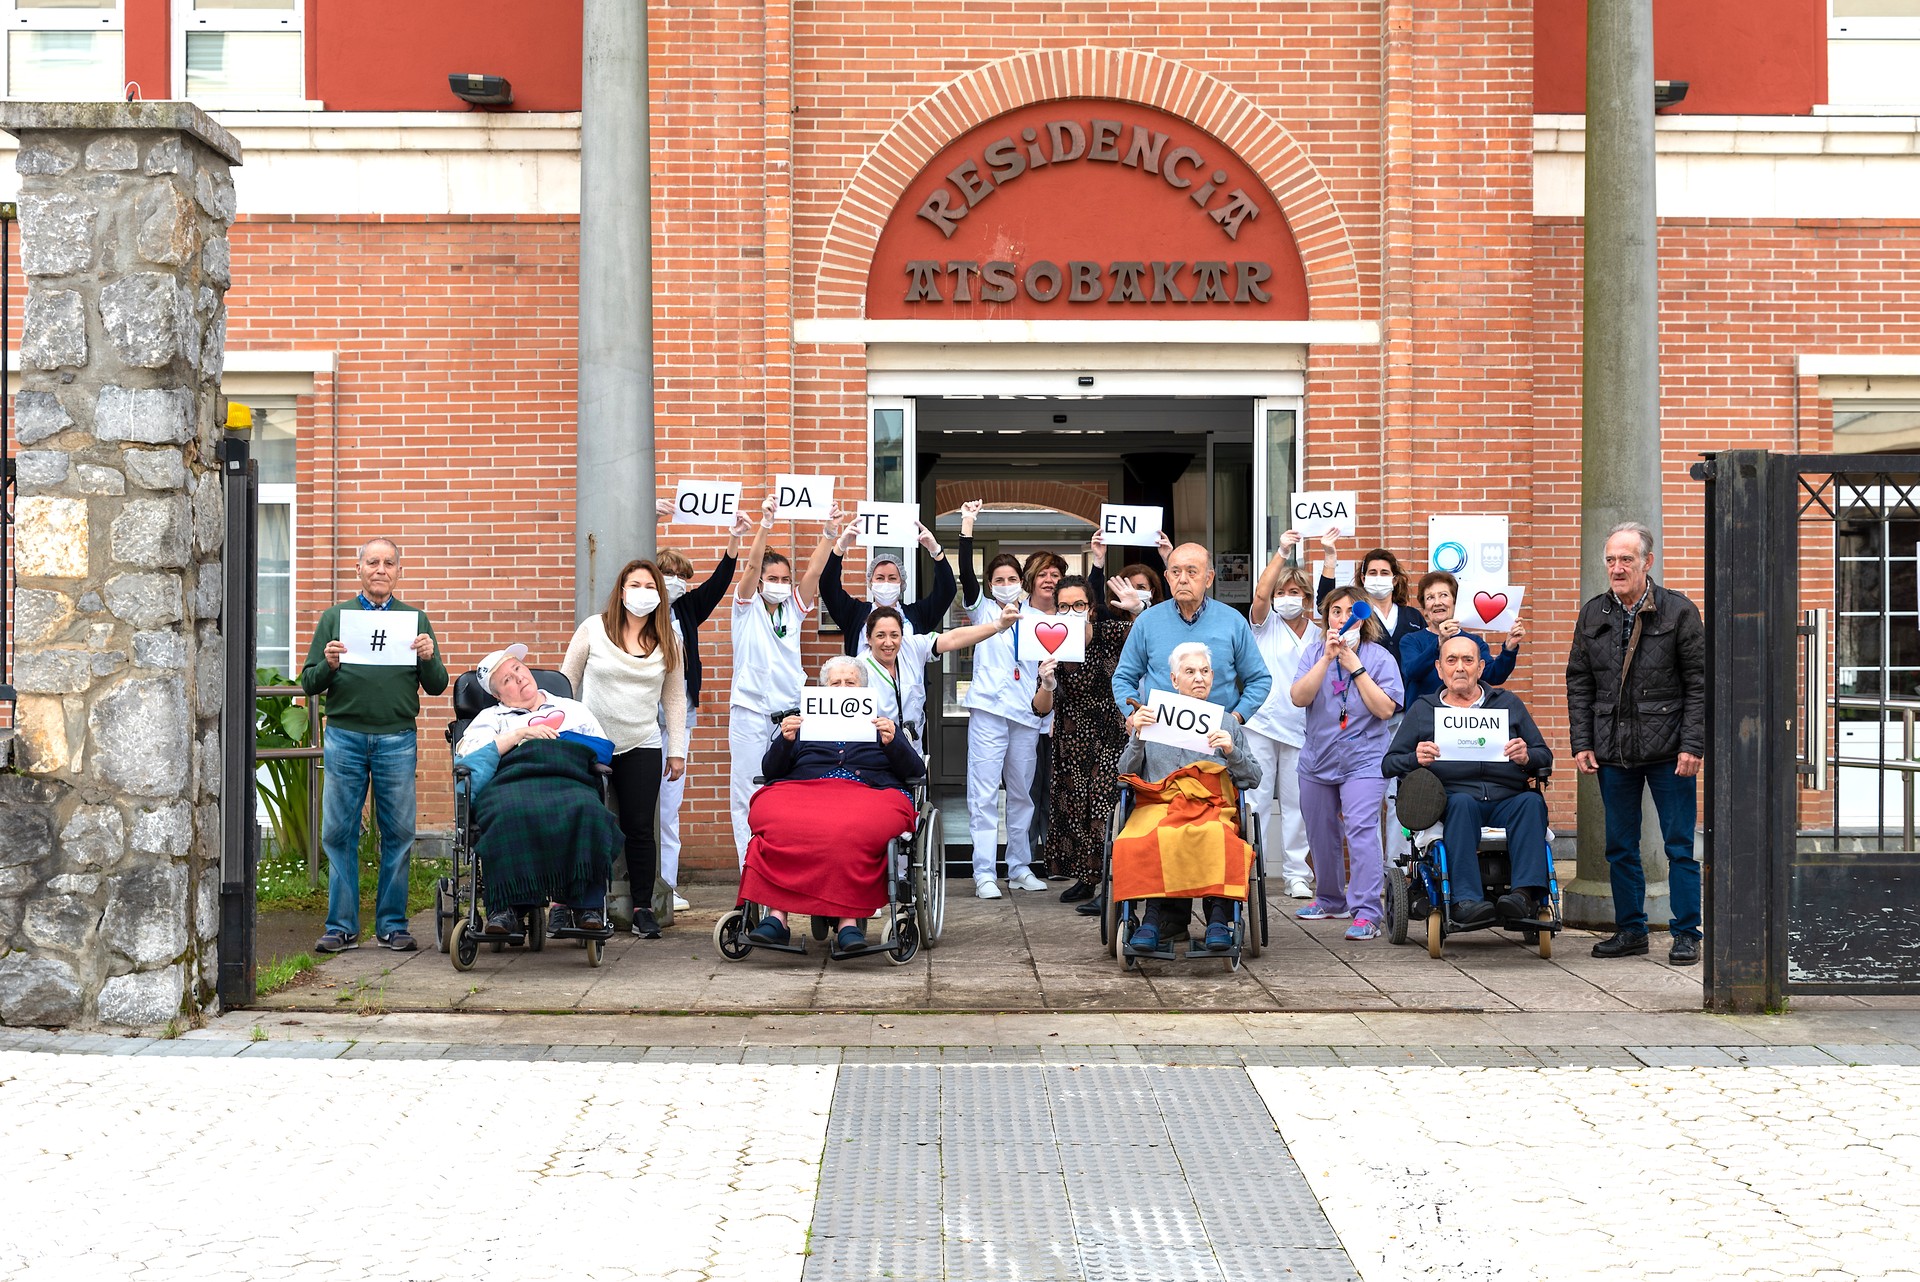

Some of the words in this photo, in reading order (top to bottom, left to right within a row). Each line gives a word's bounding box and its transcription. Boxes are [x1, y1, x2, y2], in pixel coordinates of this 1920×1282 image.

[904, 260, 1272, 303] ATSOBAKAR
[679, 492, 735, 517] QUE
[779, 486, 812, 508] DA
[1295, 501, 1348, 520] CASA
[860, 513, 889, 535] TE
[1105, 514, 1137, 534] EN
[370, 629, 387, 652] #
[806, 697, 873, 719] ELL@S
[1156, 703, 1211, 735] NOS
[1443, 716, 1500, 729] CUIDAN
